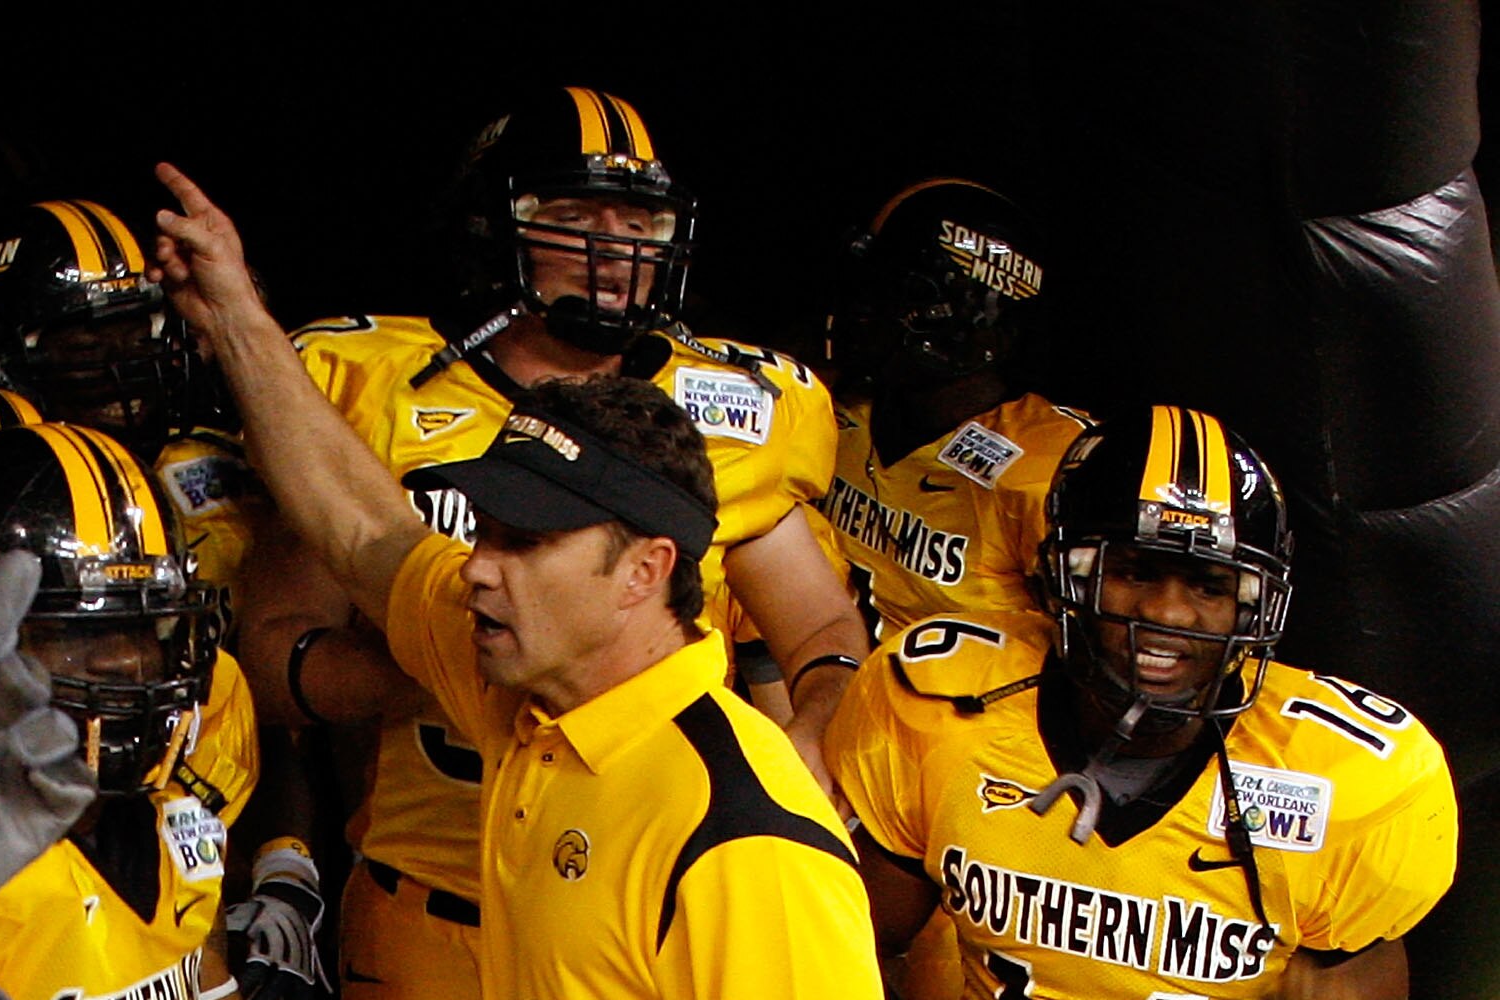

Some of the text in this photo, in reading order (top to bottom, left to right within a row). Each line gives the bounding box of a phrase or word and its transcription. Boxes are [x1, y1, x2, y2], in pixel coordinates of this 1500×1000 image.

[938, 219, 1043, 291] SOUTHERN
[971, 257, 1017, 297] MISS
[462, 314, 510, 352] ADAMS
[677, 333, 730, 363] ADAMS
[1160, 508, 1211, 526] ATTACK
[893, 510, 971, 586] MISS
[1257, 793, 1317, 816] ORLEANS
[940, 844, 1281, 984] SOUTHERN MISS
